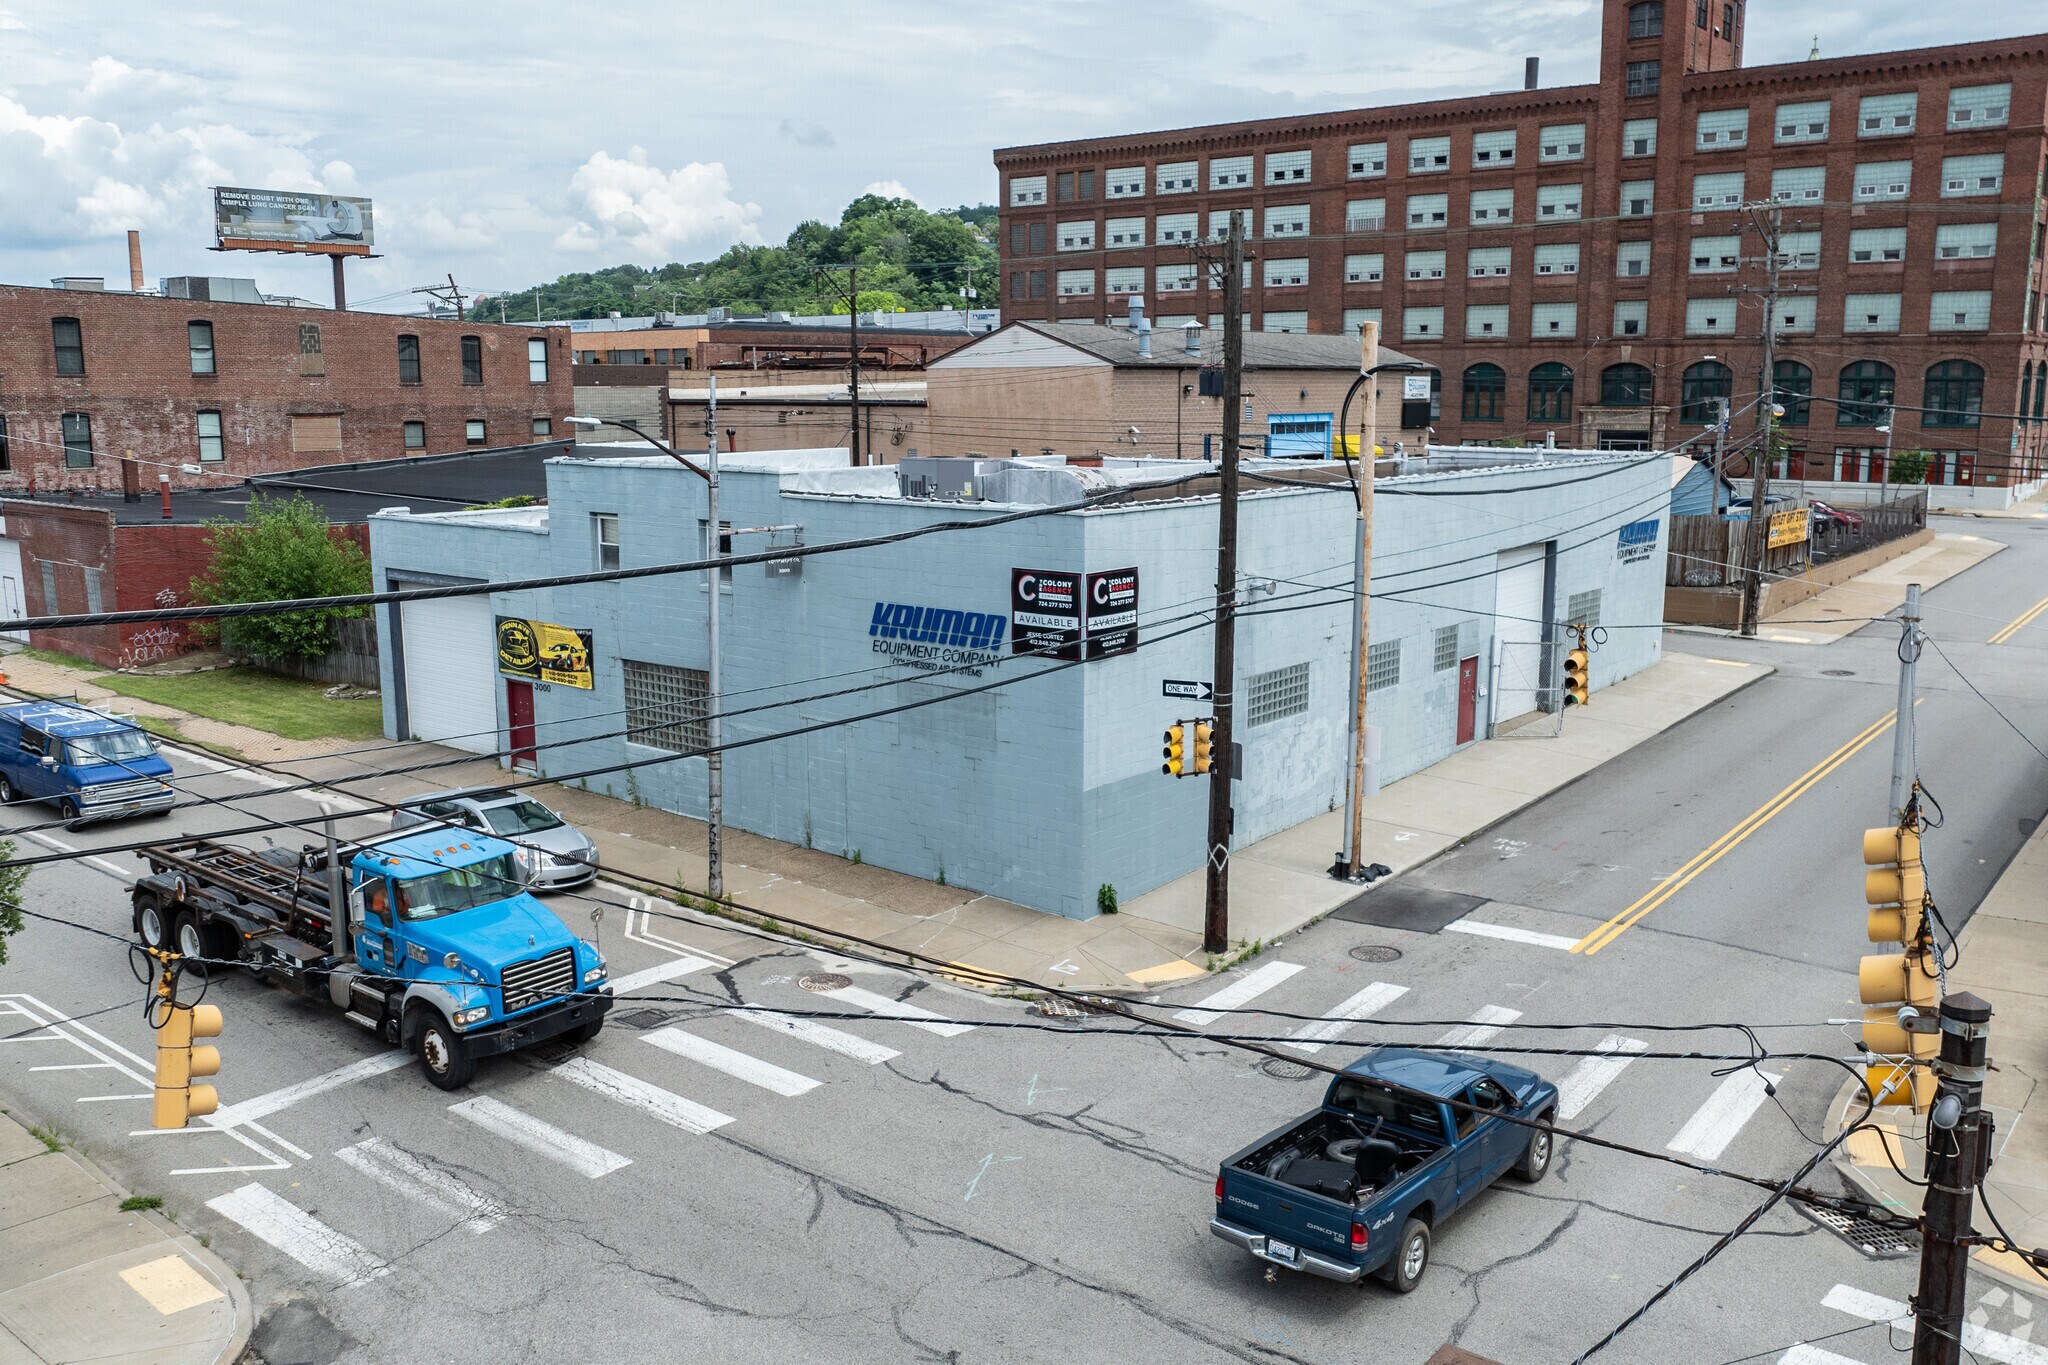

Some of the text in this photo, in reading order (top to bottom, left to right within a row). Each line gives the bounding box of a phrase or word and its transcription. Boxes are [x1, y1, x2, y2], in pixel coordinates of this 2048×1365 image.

[220, 191, 309, 205] REMOVE DOUBT WITH ONE
[221, 199, 247, 207] SIMPLE
[248, 201, 268, 209] LUNG
[268, 202, 297, 210] CANCER
[1042, 579, 1073, 588] COLONY
[1111, 576, 1135, 586] COLONY
[1042, 586, 1073, 594] AGENCY
[1111, 583, 1135, 592] AGENCY
[1019, 615, 1073, 628] AVAILABLE
[1092, 613, 1134, 628] AVAILABLE
[501, 621, 518, 631] PENN
[518, 622, 531, 635] AVE
[868, 602, 1007, 652] KRUMAN
[1026, 631, 1065, 641] JESSE CORTEZ
[499, 649, 535, 666] DETAILING
[872, 639, 1004, 669] EQUIPMENT COMPANY
[938, 664, 950, 672] AIR
[534, 682, 552, 693] 3000
[1167, 684, 1198, 694] ONE WAY
[1228, 1195, 1260, 1210] DODGE
[1306, 1222, 1346, 1239] DAKOTA
